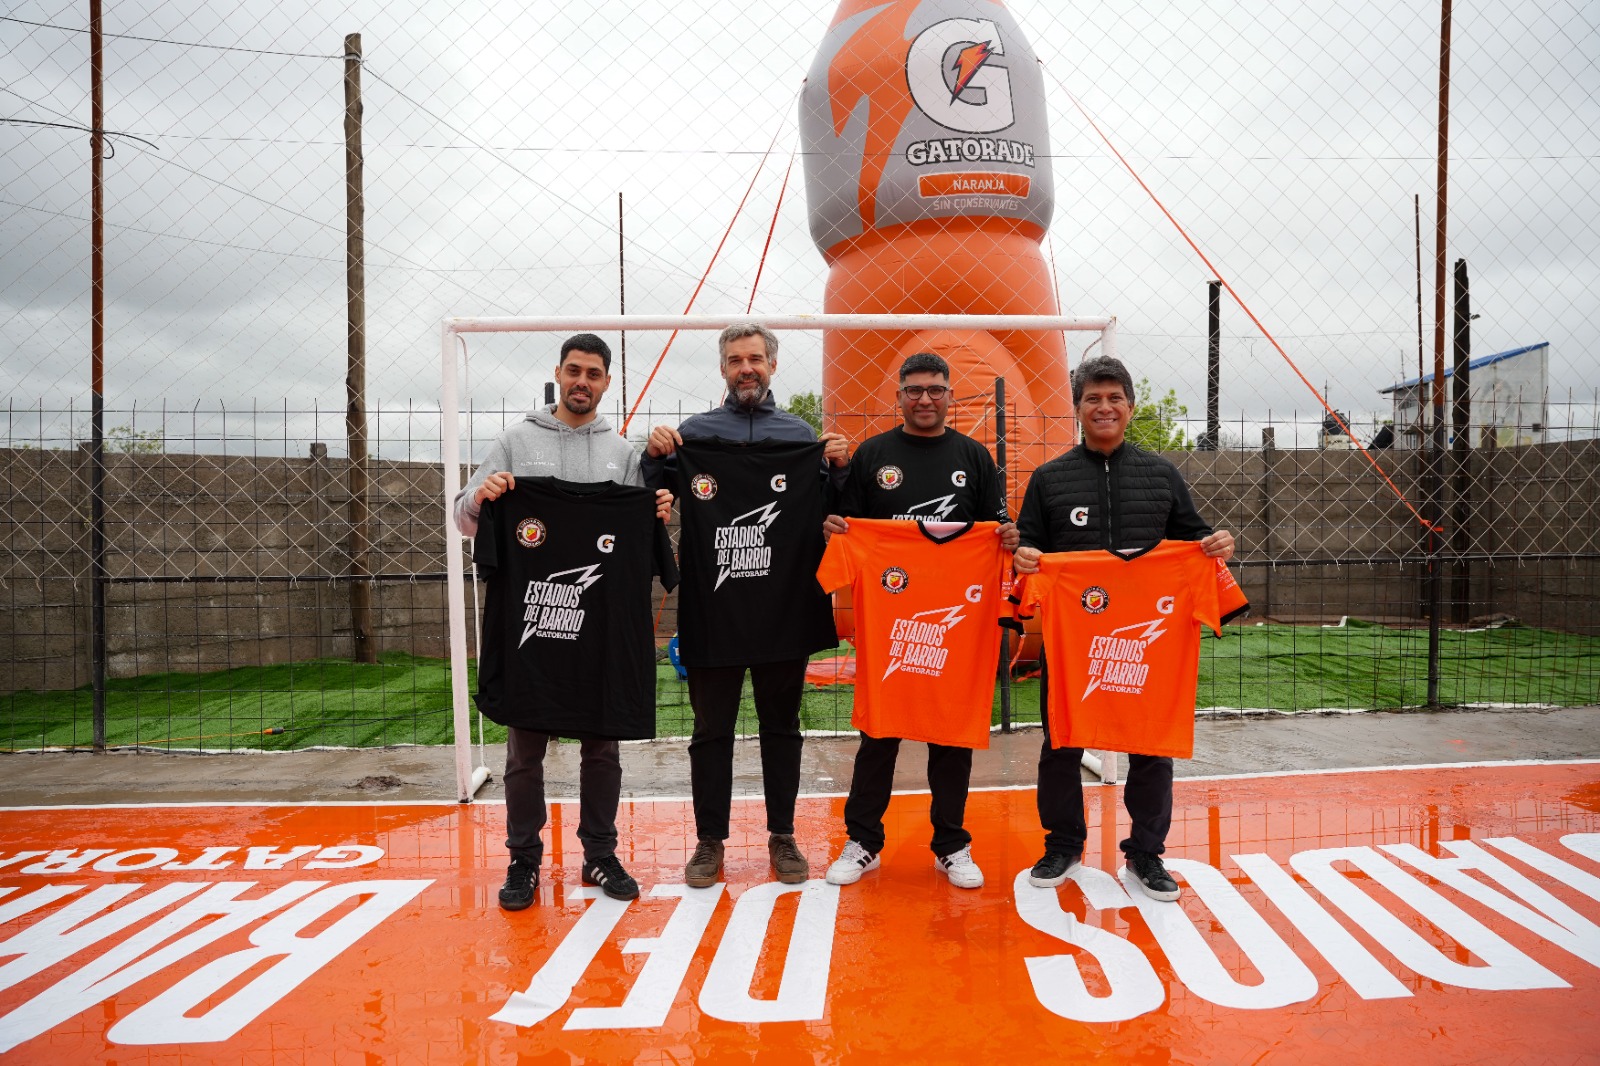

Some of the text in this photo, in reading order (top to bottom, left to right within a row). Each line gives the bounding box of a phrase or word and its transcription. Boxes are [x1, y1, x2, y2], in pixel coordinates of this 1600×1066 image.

[905, 17, 1015, 134] G
[906, 138, 1035, 168] GATORADE
[953, 178, 1005, 191] NARANJA
[933, 197, 1019, 211] SIN CONSERVANTES
[770, 474, 787, 492] G
[951, 470, 967, 488] G
[1070, 506, 1089, 526] G
[596, 534, 616, 553] G
[714, 524, 766, 549] ESTADIOS
[717, 546, 772, 571] DEL BARRIO
[730, 569, 769, 579] GATORADE
[523, 580, 584, 609] ESTADIOS
[965, 584, 983, 603] G
[1156, 595, 1175, 615] G
[523, 604, 585, 633] DEL BARRIO
[536, 630, 578, 640] GATORADE
[889, 618, 947, 646] ESTADIOS
[889, 641, 949, 670] DEL BARRIO
[1088, 635, 1147, 663] ESTADIOS
[901, 665, 941, 677] GATORADE
[1088, 659, 1149, 687] DEL BARRIO
[1100, 684, 1142, 695] GATORADE
[488, 878, 841, 1031] DEL
